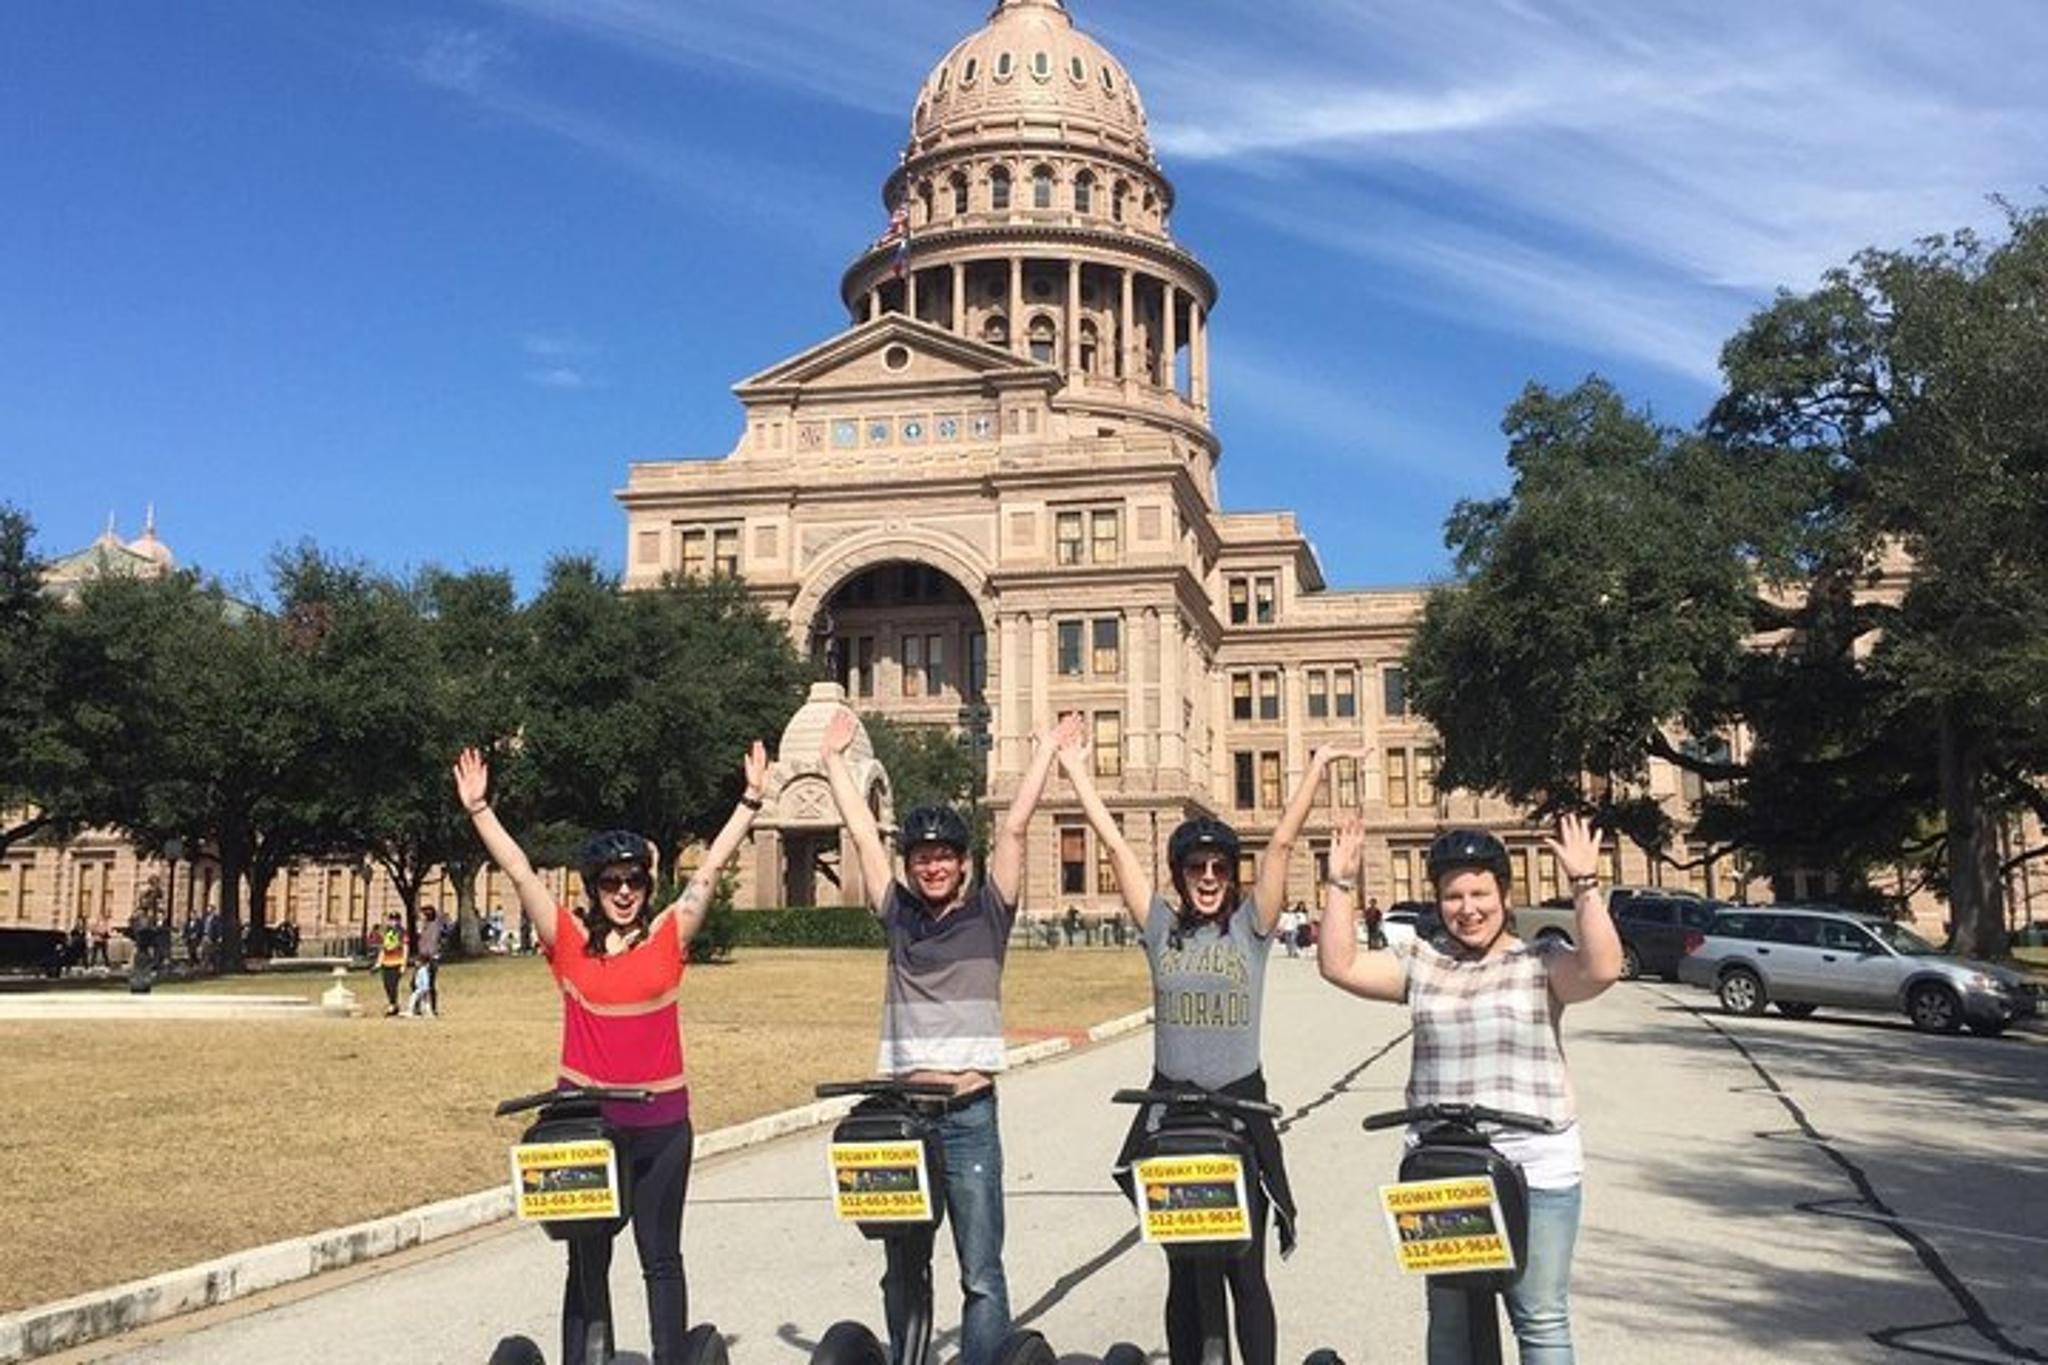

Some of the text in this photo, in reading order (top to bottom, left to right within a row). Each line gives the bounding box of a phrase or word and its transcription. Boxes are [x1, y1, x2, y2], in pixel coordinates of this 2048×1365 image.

[517, 1148, 609, 1163] SEGWAY TOURS
[832, 1149, 919, 1161] SEGWAY TOURS
[1140, 1162, 1239, 1177] SEGWAY TOURS
[1387, 1185, 1492, 1206] SEGWAY TOURS
[1149, 1210, 1242, 1226] 512-663-9634
[1404, 1237, 1502, 1257] 512-663-9634
